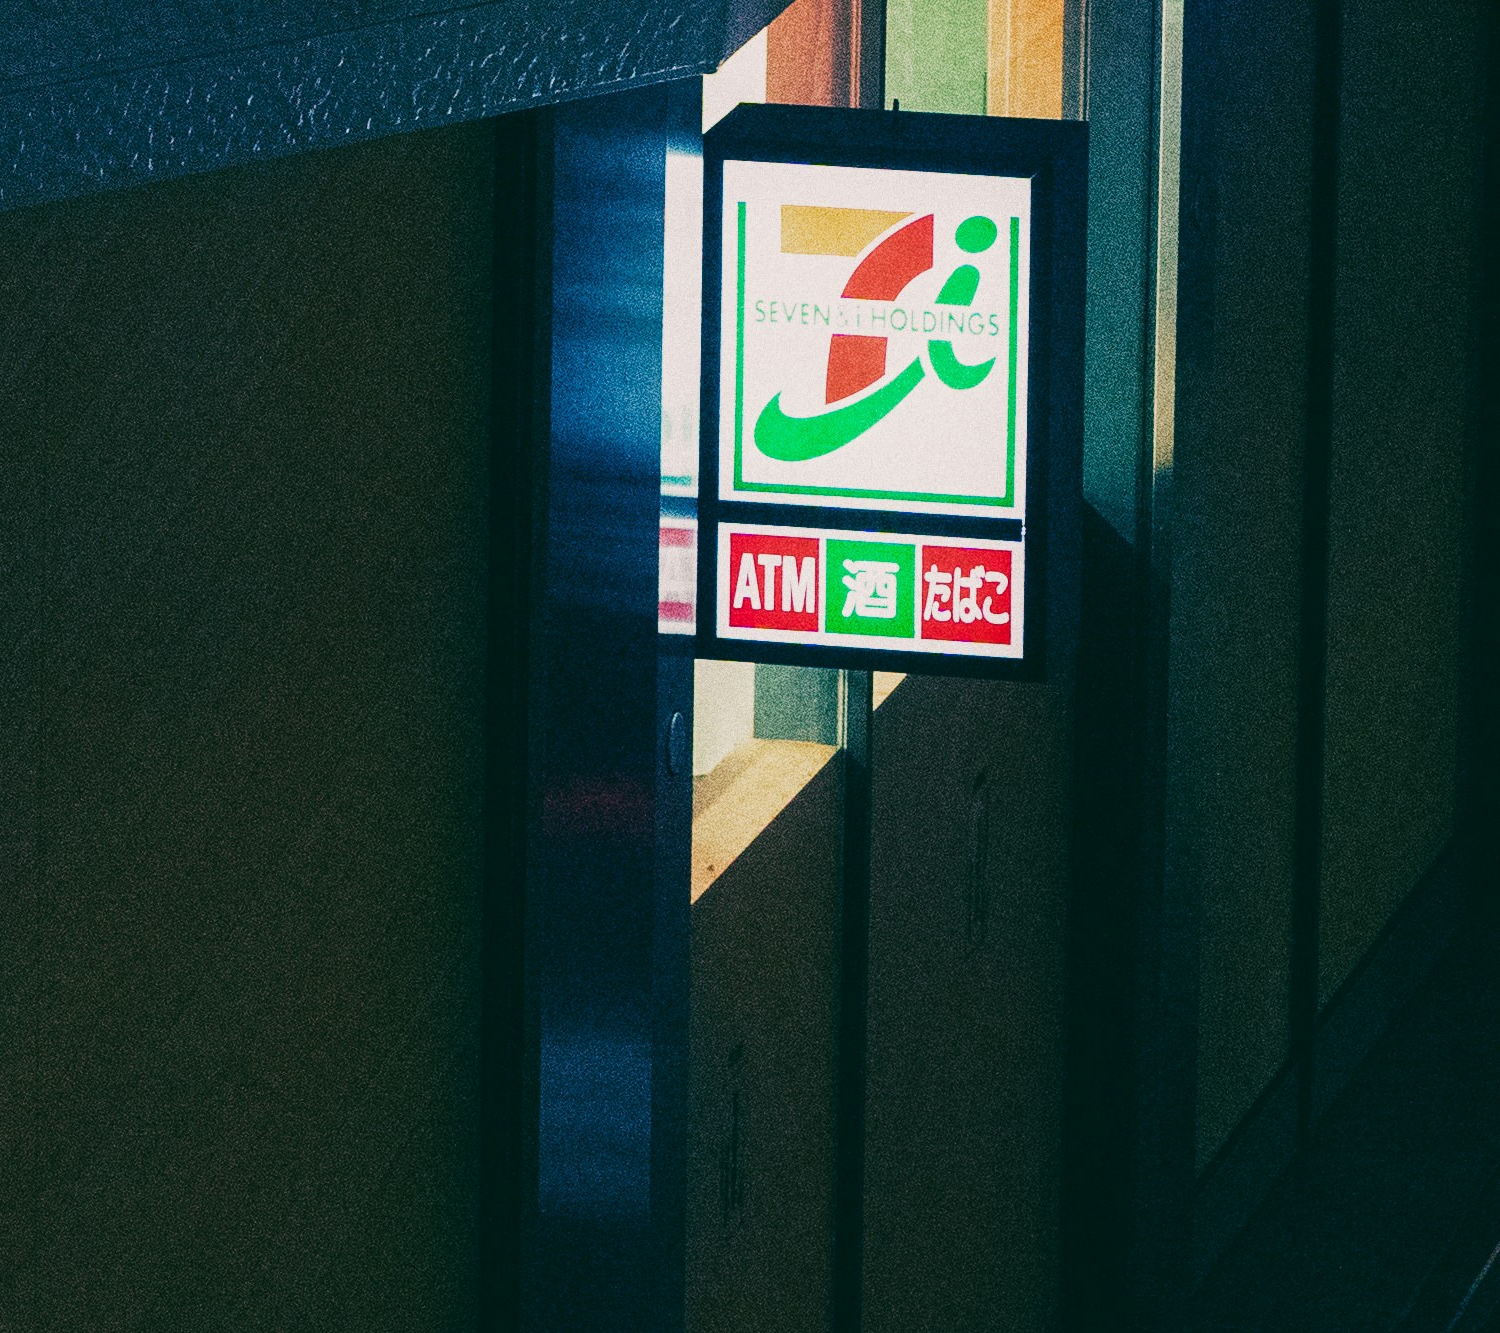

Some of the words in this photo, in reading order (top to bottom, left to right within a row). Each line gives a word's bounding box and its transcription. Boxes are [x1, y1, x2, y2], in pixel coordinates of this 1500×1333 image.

[871, 304, 1000, 337] HOLDINGS
[734, 553, 816, 615] ATM
[841, 558, 899, 621] 酒
[923, 563, 1011, 626] たばこ
